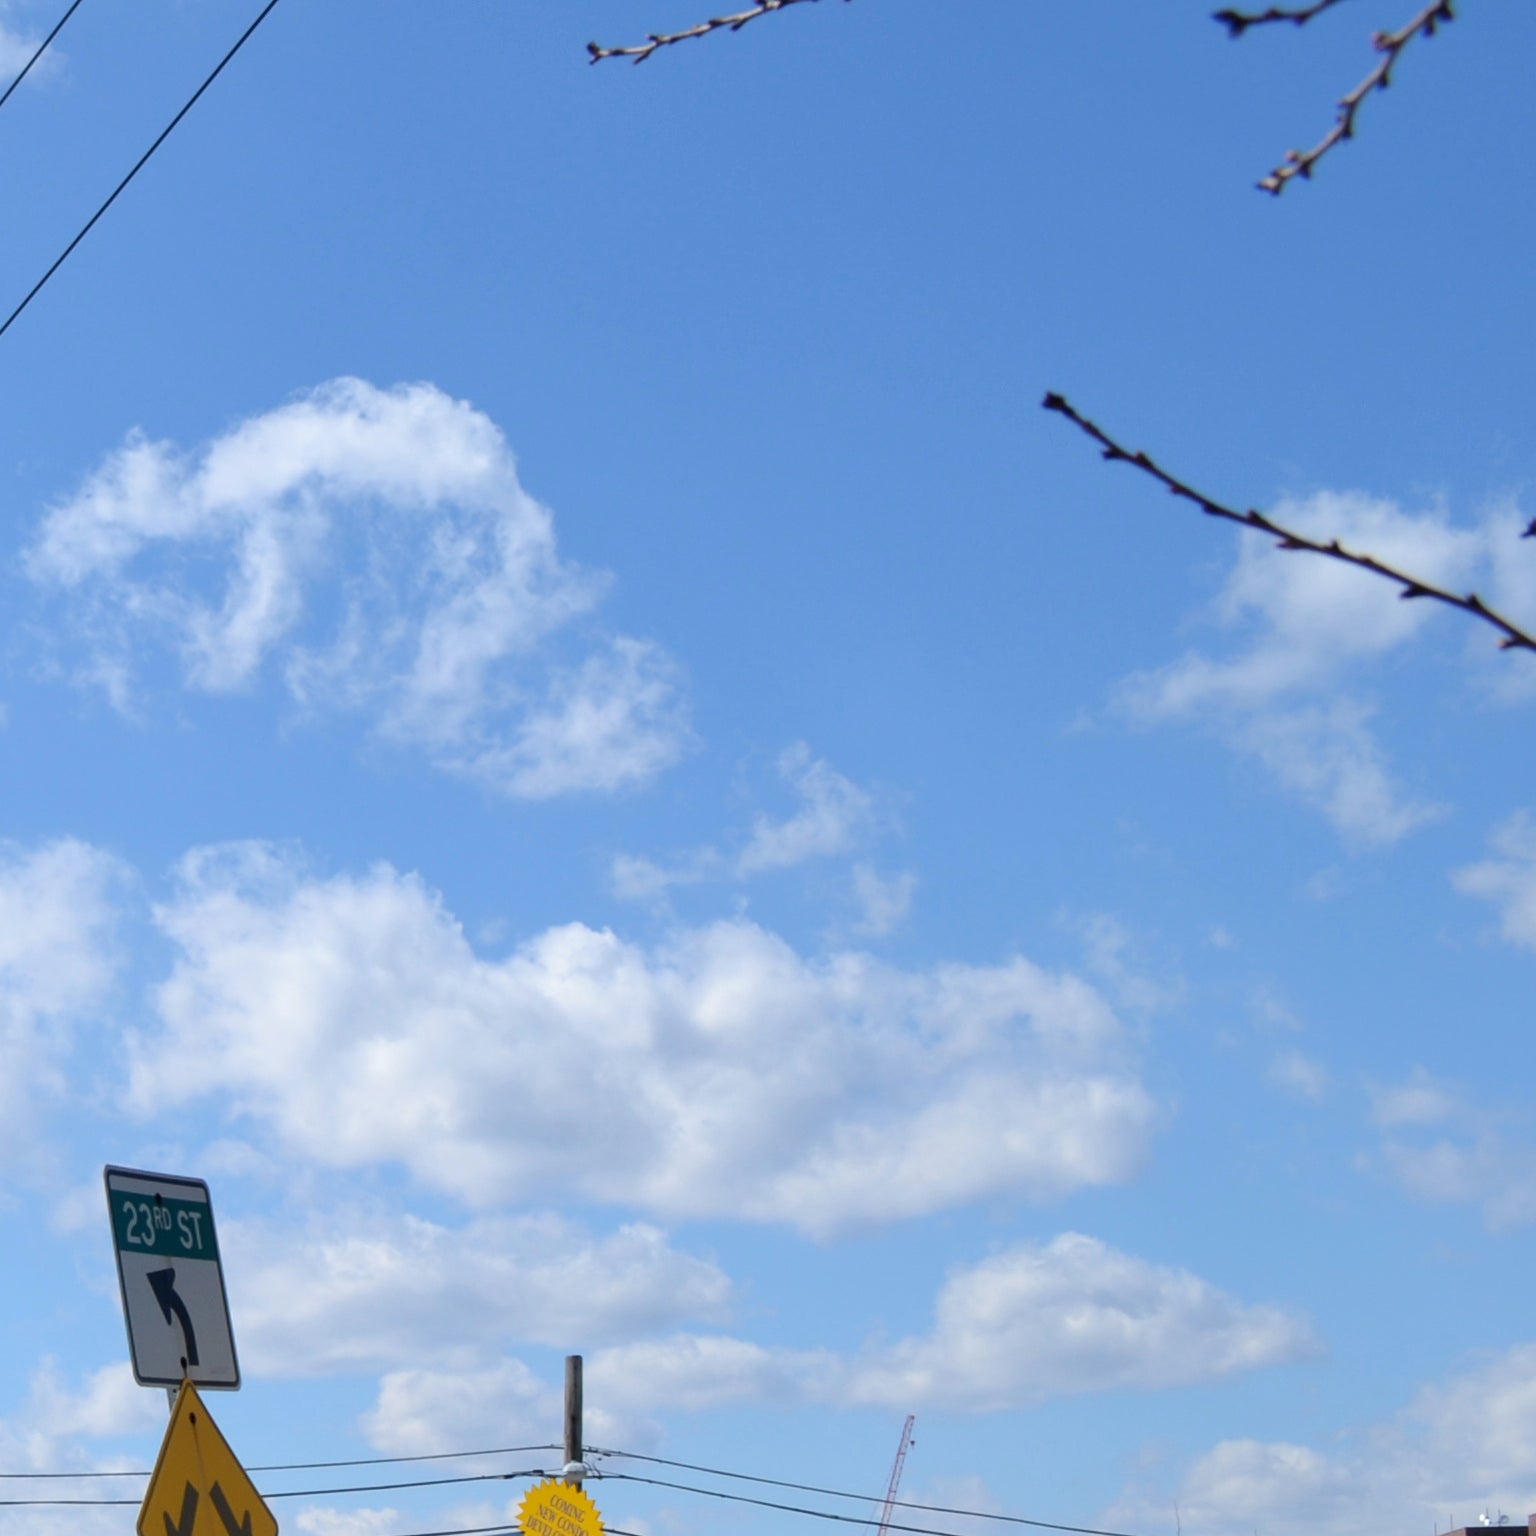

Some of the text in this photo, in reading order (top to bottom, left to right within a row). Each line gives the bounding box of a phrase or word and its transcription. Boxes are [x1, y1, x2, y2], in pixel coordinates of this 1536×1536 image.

[123, 1201, 202, 1250] 23RD ST
[537, 1503, 556, 1524] NEW
[550, 1494, 585, 1524] COMING
